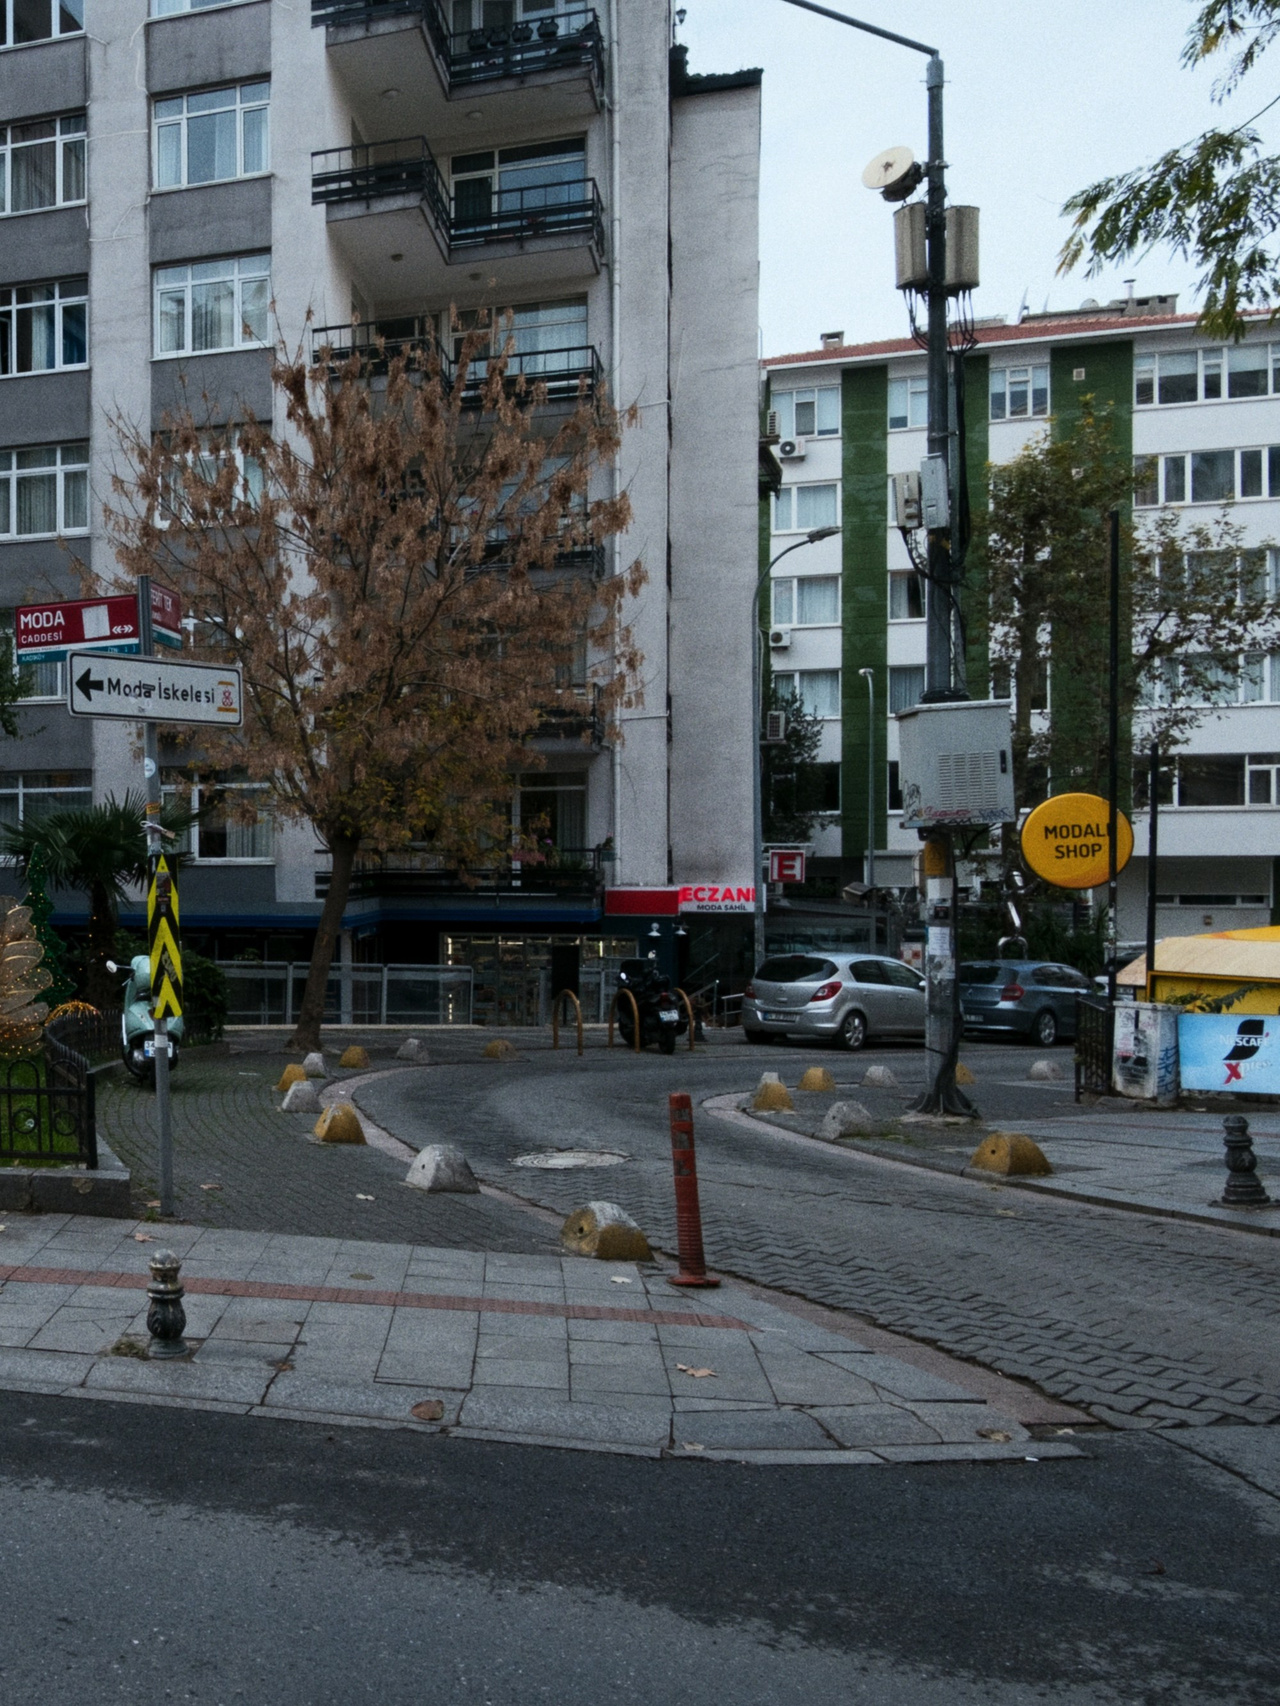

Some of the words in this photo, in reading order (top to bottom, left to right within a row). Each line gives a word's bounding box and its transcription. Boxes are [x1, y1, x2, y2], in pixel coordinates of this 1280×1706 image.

[20, 610, 66, 630] MODA
[21, 629, 63, 645] CADDESİ
[107, 677, 153, 699] Moda
[158, 676, 216, 704] İskelesi
[1054, 843, 1102, 860] SHOP
[777, 855, 797, 881] E
